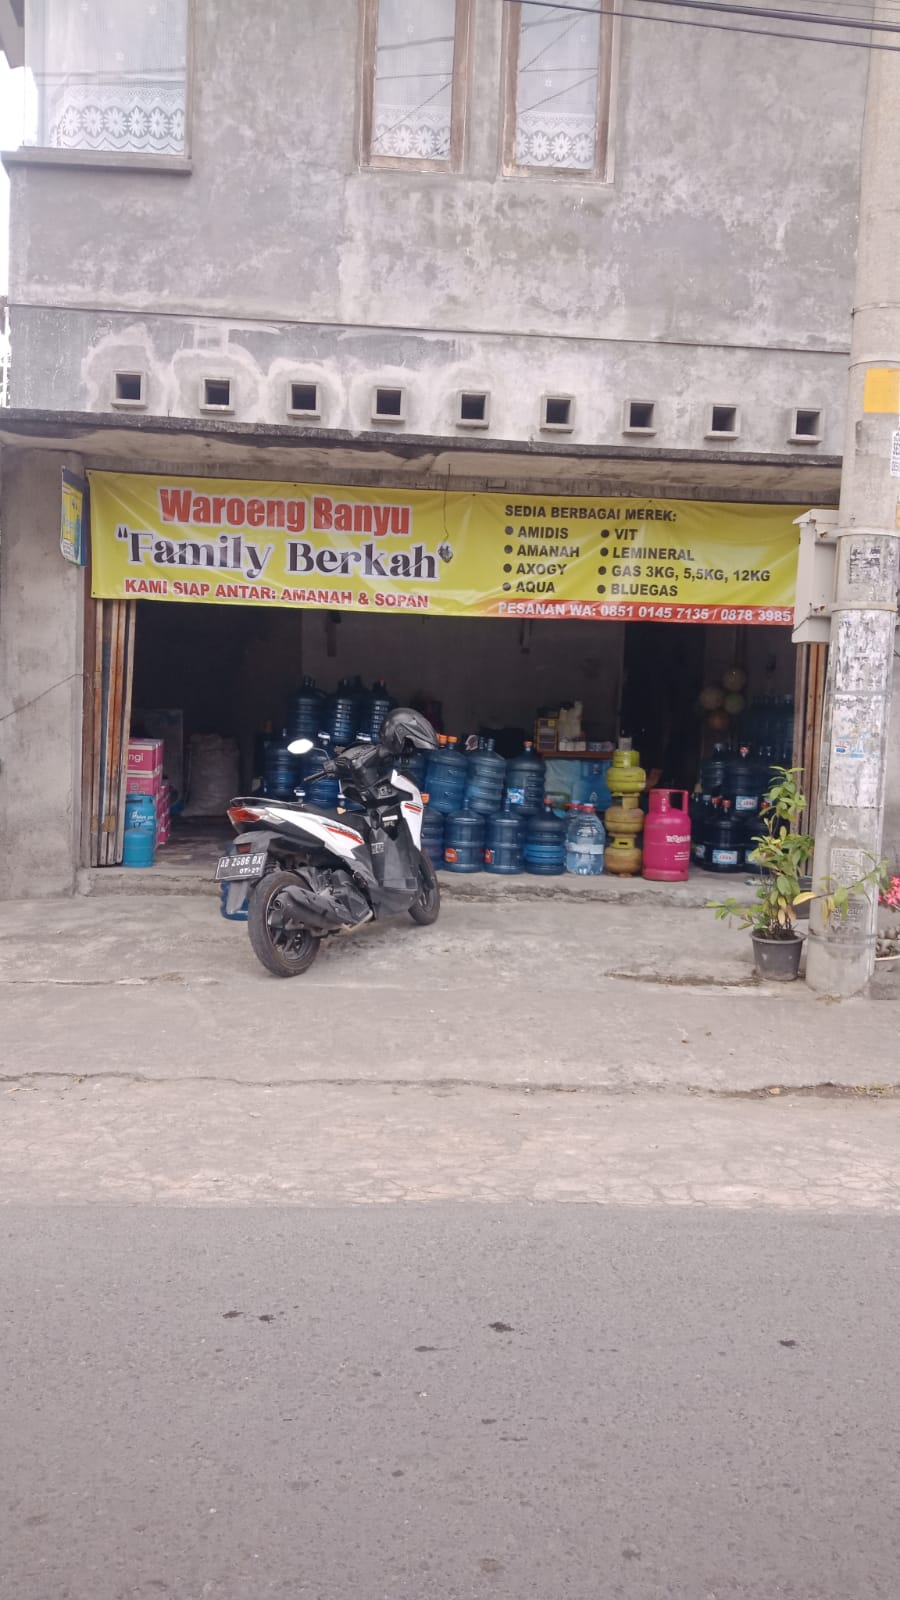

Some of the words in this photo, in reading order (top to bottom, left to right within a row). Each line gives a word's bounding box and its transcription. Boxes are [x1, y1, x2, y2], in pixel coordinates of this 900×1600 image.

[159, 488, 305, 533] Waroeng
[313, 497, 410, 537] Banyu
[505, 505, 546, 518] SEDIA
[551, 506, 621, 520] BERBAGAI
[625, 508, 677, 522] MEREK:
[517, 526, 568, 540] AMIDIS
[614, 528, 638, 541] VIT
[516, 545, 580, 558] AMANAH
[612, 547, 695, 562] LEMINERAL
[515, 562, 567, 576] AXOGY
[611, 565, 641, 579] GAS
[645, 566, 679, 582] 3KG,
[683, 567, 729, 584] 5,5KG,
[733, 569, 771, 582] 12KG
[125, 579, 167, 594] KAMI
[173, 581, 210, 596] SIAP
[215, 584, 277, 600] ANTAR:
[281, 588, 352, 605] AMANAH
[357, 591, 369, 607] &
[374, 593, 430, 608] SOPAN
[515, 581, 556, 594] AQUA
[610, 583, 678, 597] BLUEGAS
[498, 602, 566, 616] PESANAN
[570, 604, 597, 617] WA:
[600, 605, 634, 618] 0851
[638, 606, 672, 619] 0145
[676, 607, 709, 620] 7135
[720, 608, 753, 621] 0878
[757, 610, 792, 623] 3985
